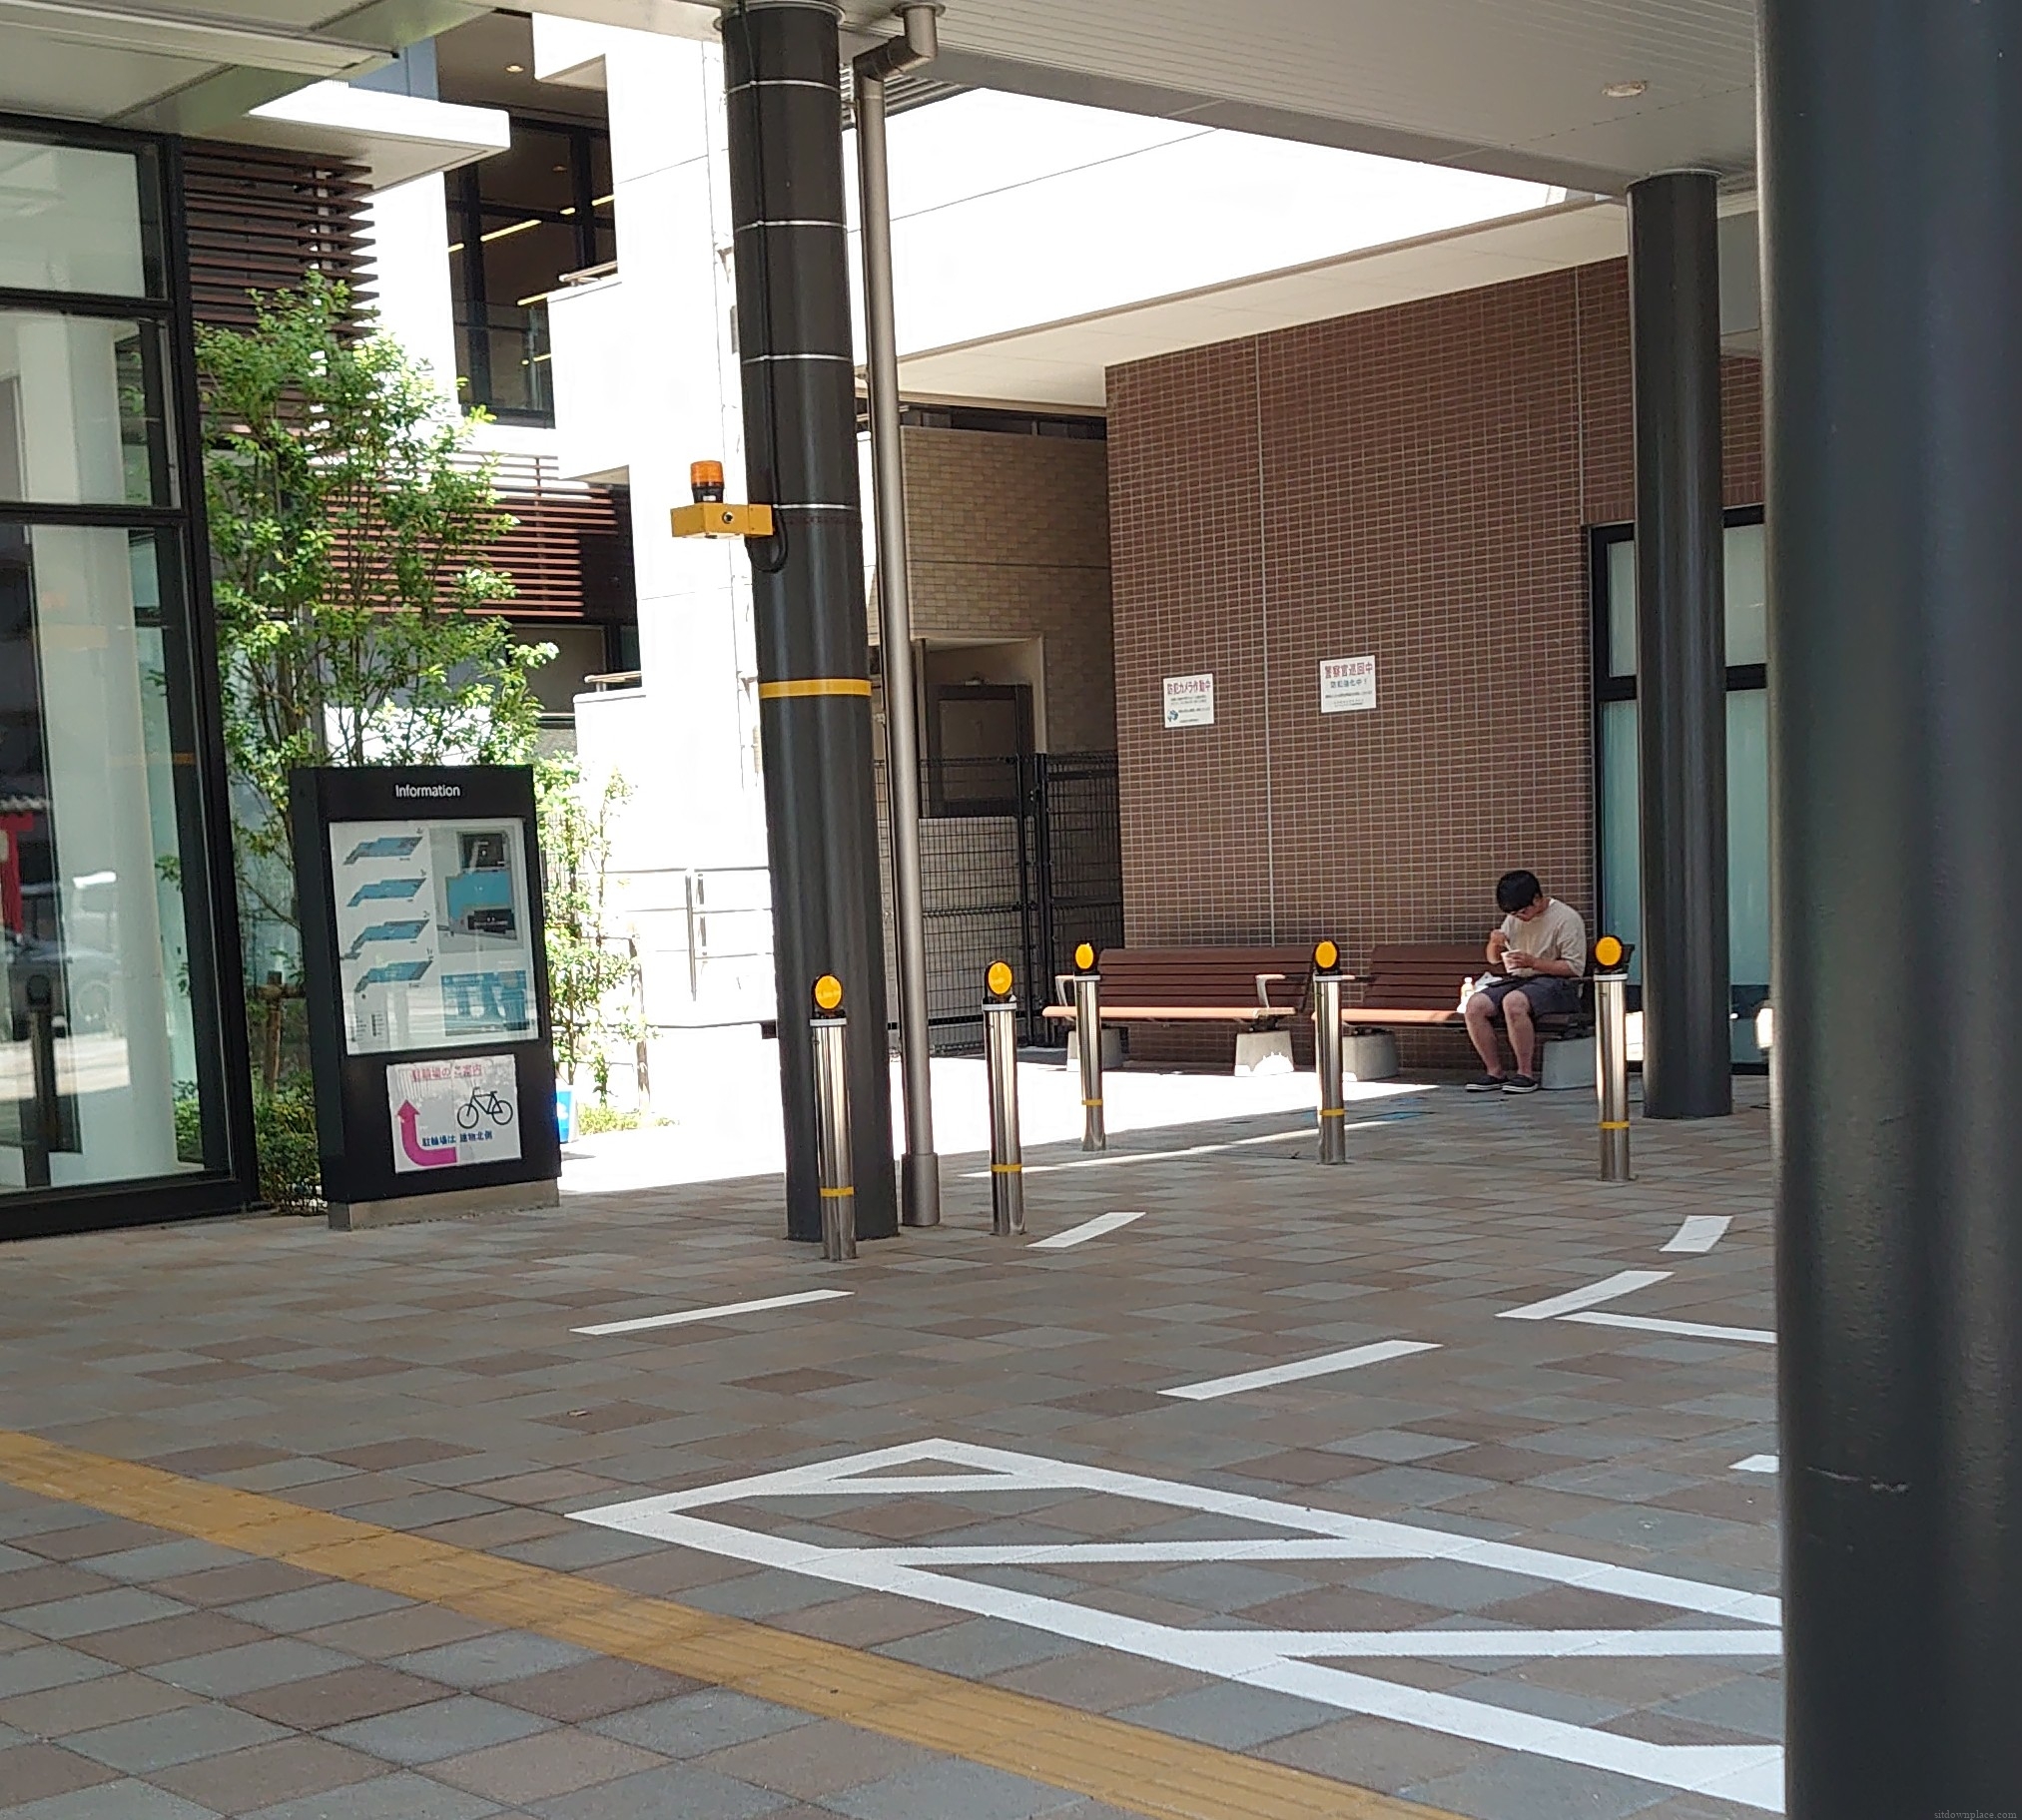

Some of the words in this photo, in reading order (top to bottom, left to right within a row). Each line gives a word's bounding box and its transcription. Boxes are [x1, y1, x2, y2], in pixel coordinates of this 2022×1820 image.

[1325, 662, 1373, 679] 警察官巡回中
[1166, 678, 1211, 696] 防犯カメラ作動中
[394, 783, 461, 798] Information
